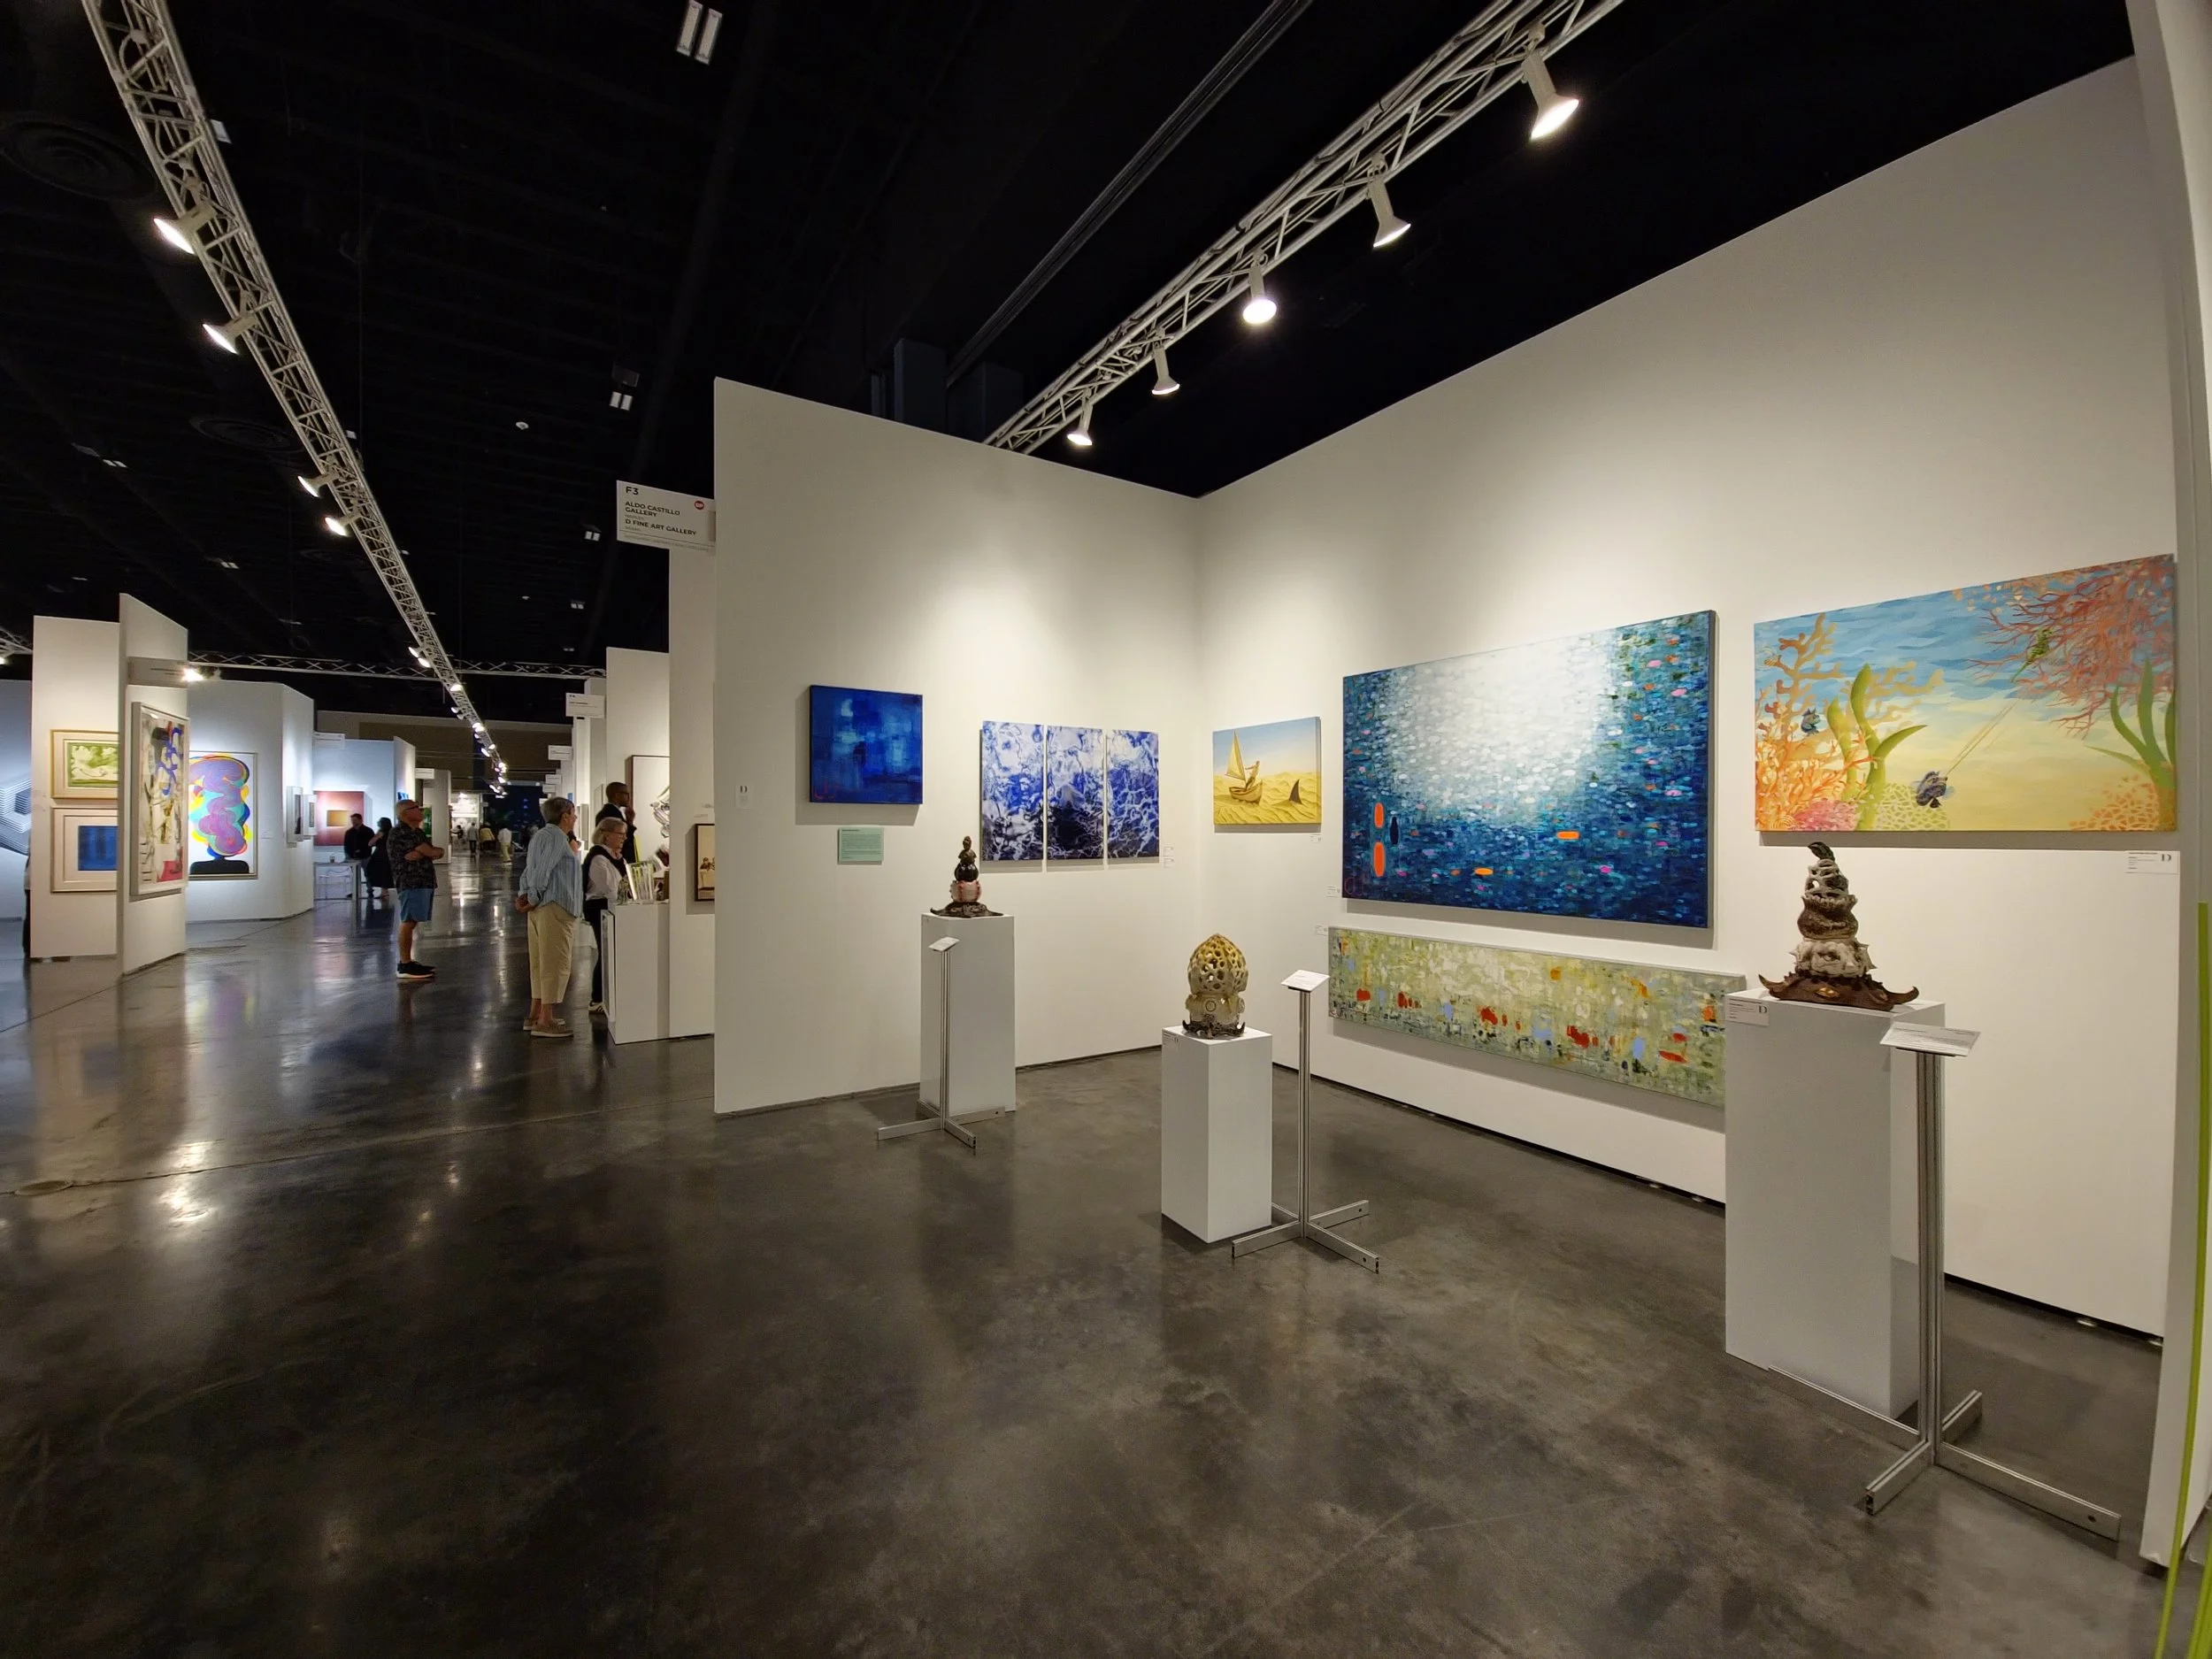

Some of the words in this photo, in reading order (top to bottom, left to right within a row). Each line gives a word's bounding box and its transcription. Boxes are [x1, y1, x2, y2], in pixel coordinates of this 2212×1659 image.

[626, 486, 639, 495] F3
[625, 507, 657, 517] GALLERY
[647, 504, 680, 516] CASTILLO
[665, 526, 696, 535] GALLERY
